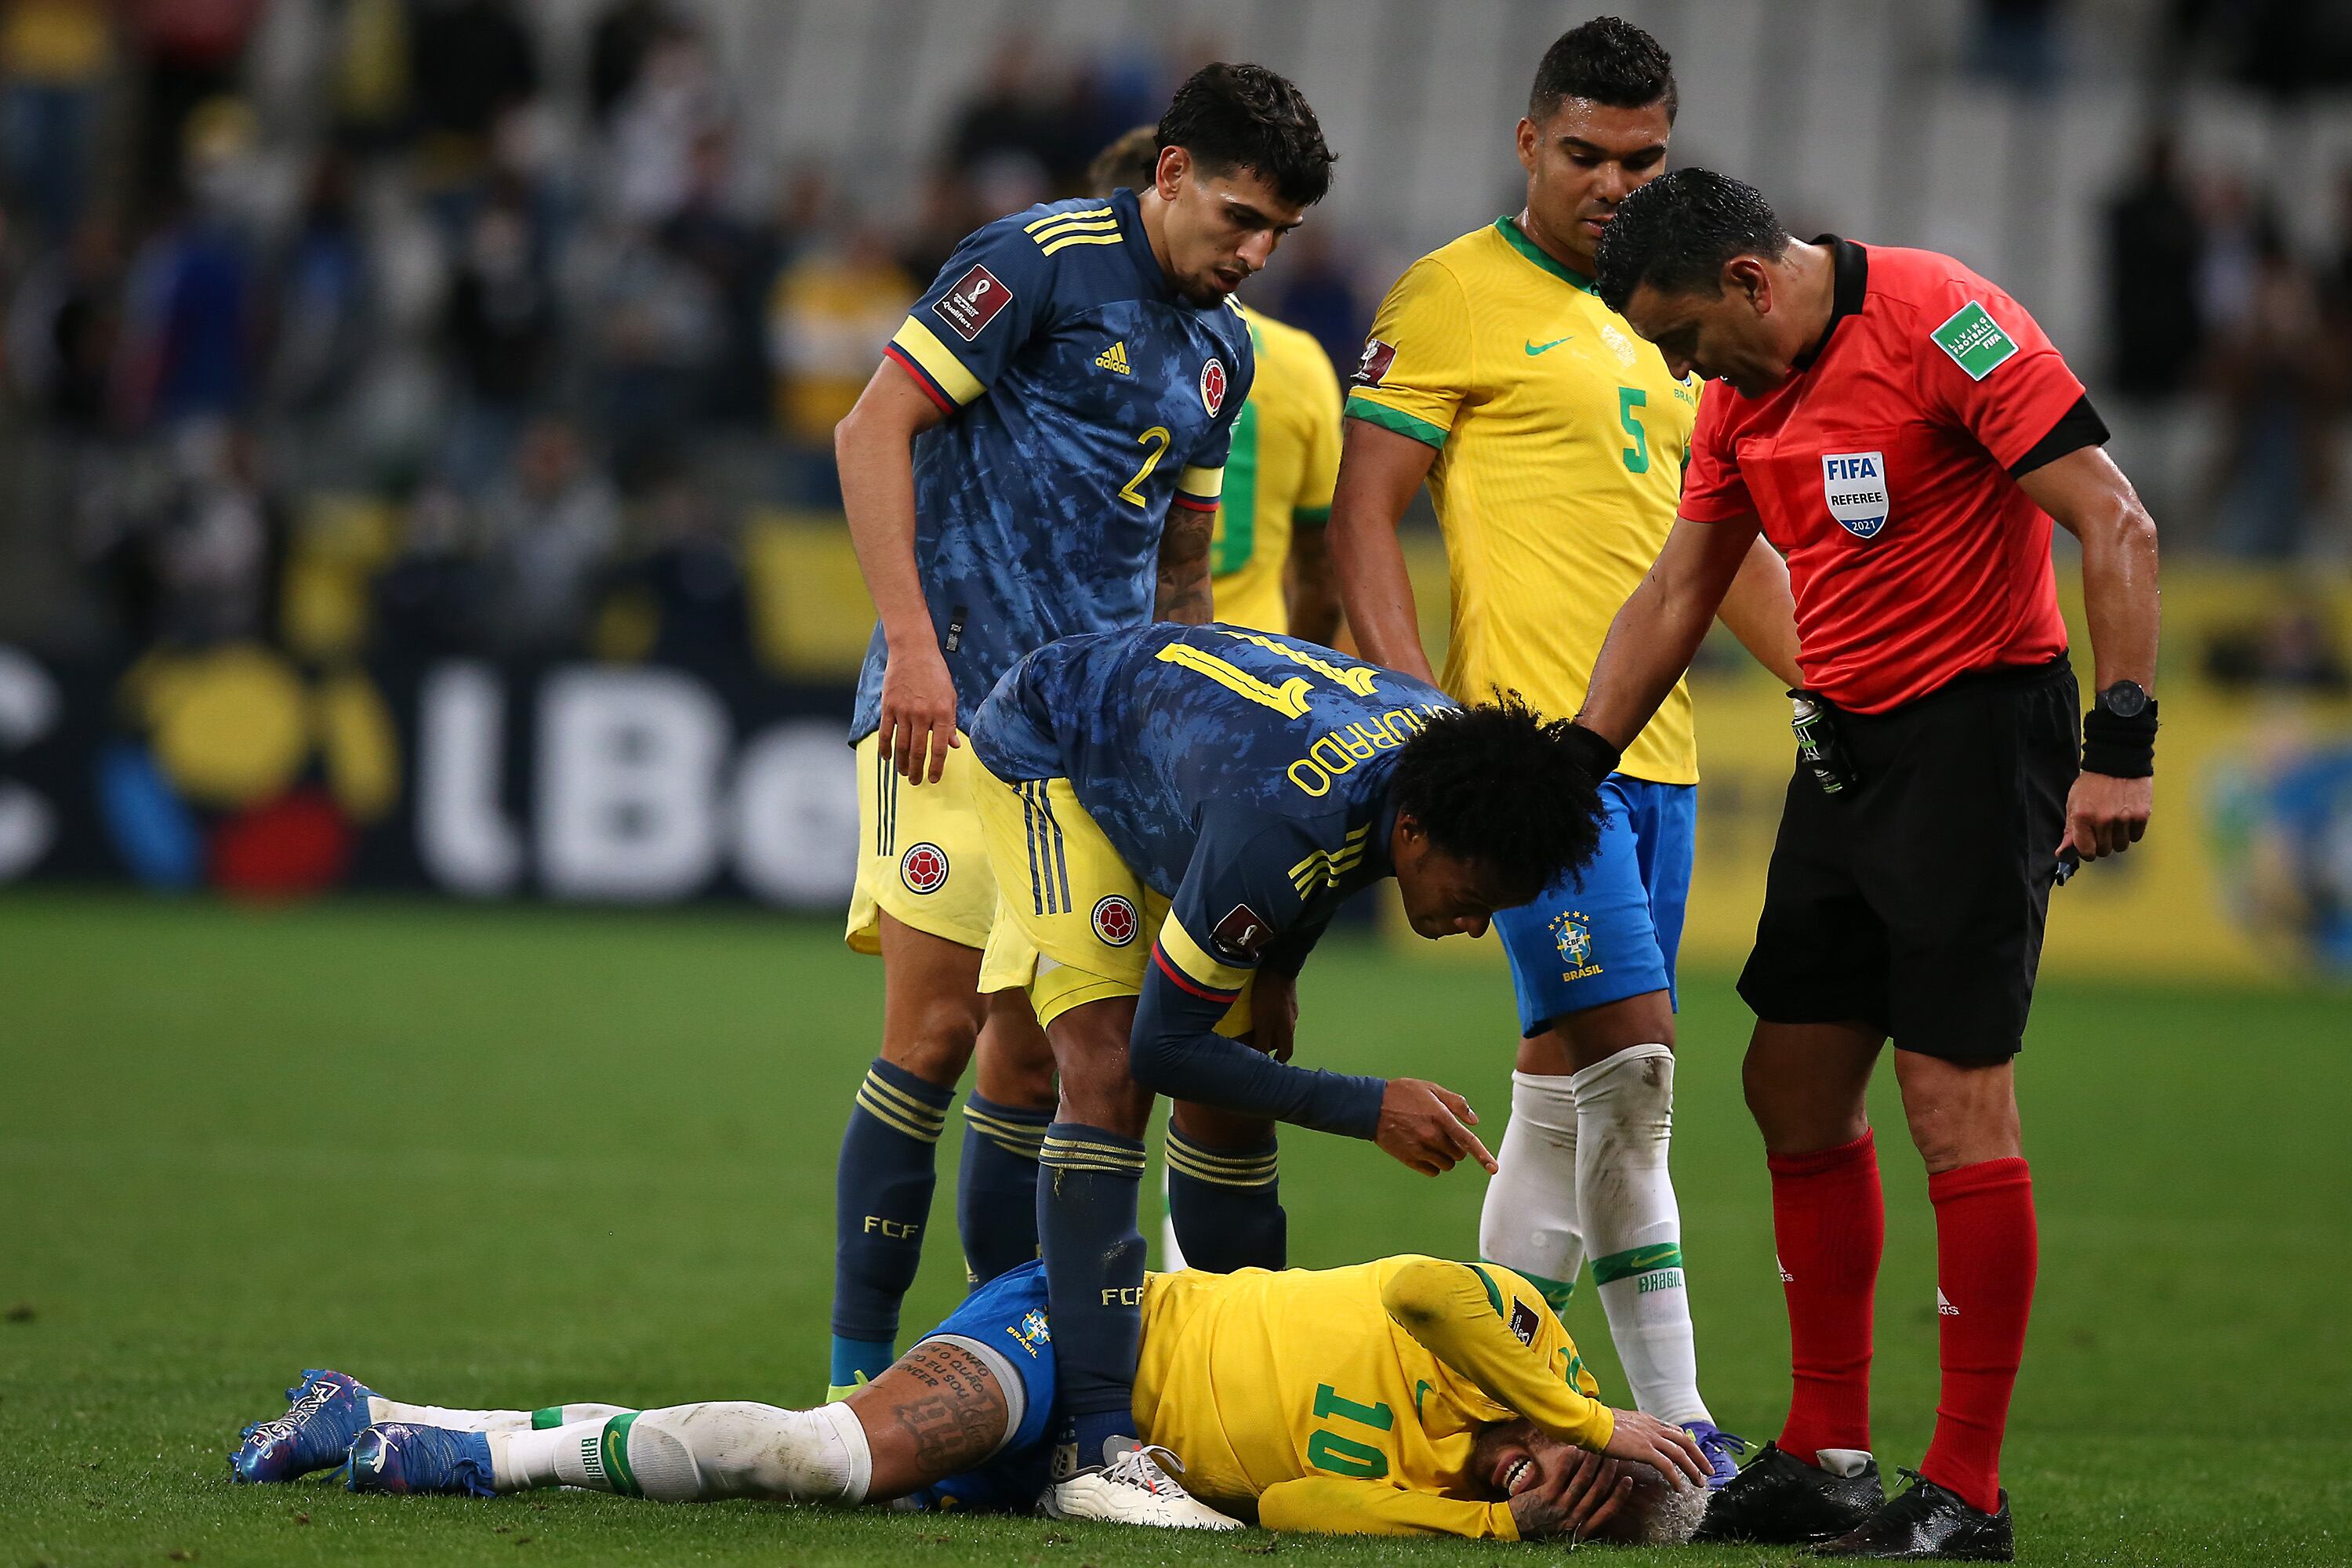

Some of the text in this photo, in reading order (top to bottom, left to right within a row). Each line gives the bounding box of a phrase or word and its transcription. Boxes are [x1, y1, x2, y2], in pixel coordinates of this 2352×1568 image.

[1947, 316, 1987, 350] LIVING
[1952, 323, 1992, 354] FOOTBALL
[1982, 332, 2002, 350] FIFA
[1095, 357, 1131, 375] adidas
[1618, 387, 1650, 474] 5
[1118, 426, 1171, 509] 2
[1827, 458, 1878, 480] FIFA
[1831, 492, 1883, 506] REFEREE
[1851, 520, 1876, 531] 2021
[1566, 938, 1581, 946] CBF
[1563, 964, 1604, 982] BRASIL
[864, 1215, 919, 1239] FCF
[1639, 1270, 1682, 1294] BRASIL
[1006, 1326, 1038, 1359] BRASIL
[1307, 1382, 1395, 1479] 10
